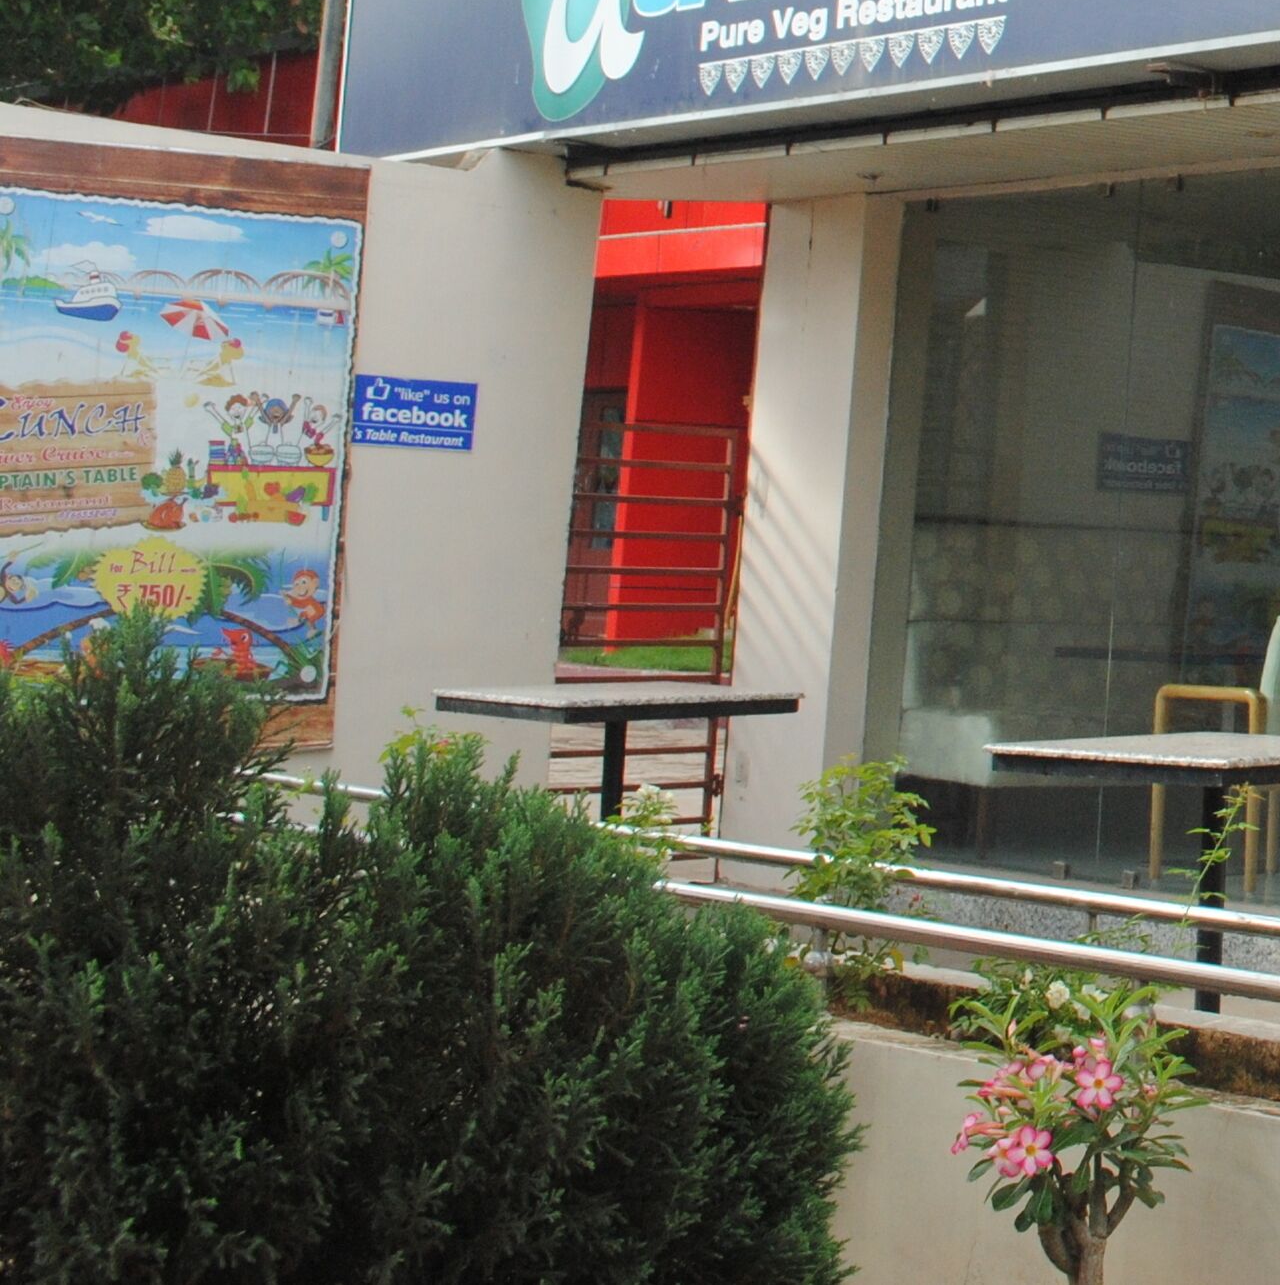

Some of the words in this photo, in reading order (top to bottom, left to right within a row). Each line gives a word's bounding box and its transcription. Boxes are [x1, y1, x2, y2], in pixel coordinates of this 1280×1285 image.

[700, 18, 766, 53] Pure
[772, 5, 828, 42] Veg
[434, 393, 449, 404] us
[453, 394, 471, 405] on
[361, 402, 467, 428] facebook
[365, 428, 398, 443] Table
[398, 431, 464, 447] Restaurant
[42, 446, 106, 463] Cruise
[83, 467, 138, 484] TABLE
[130, 550, 176, 574] Bill
